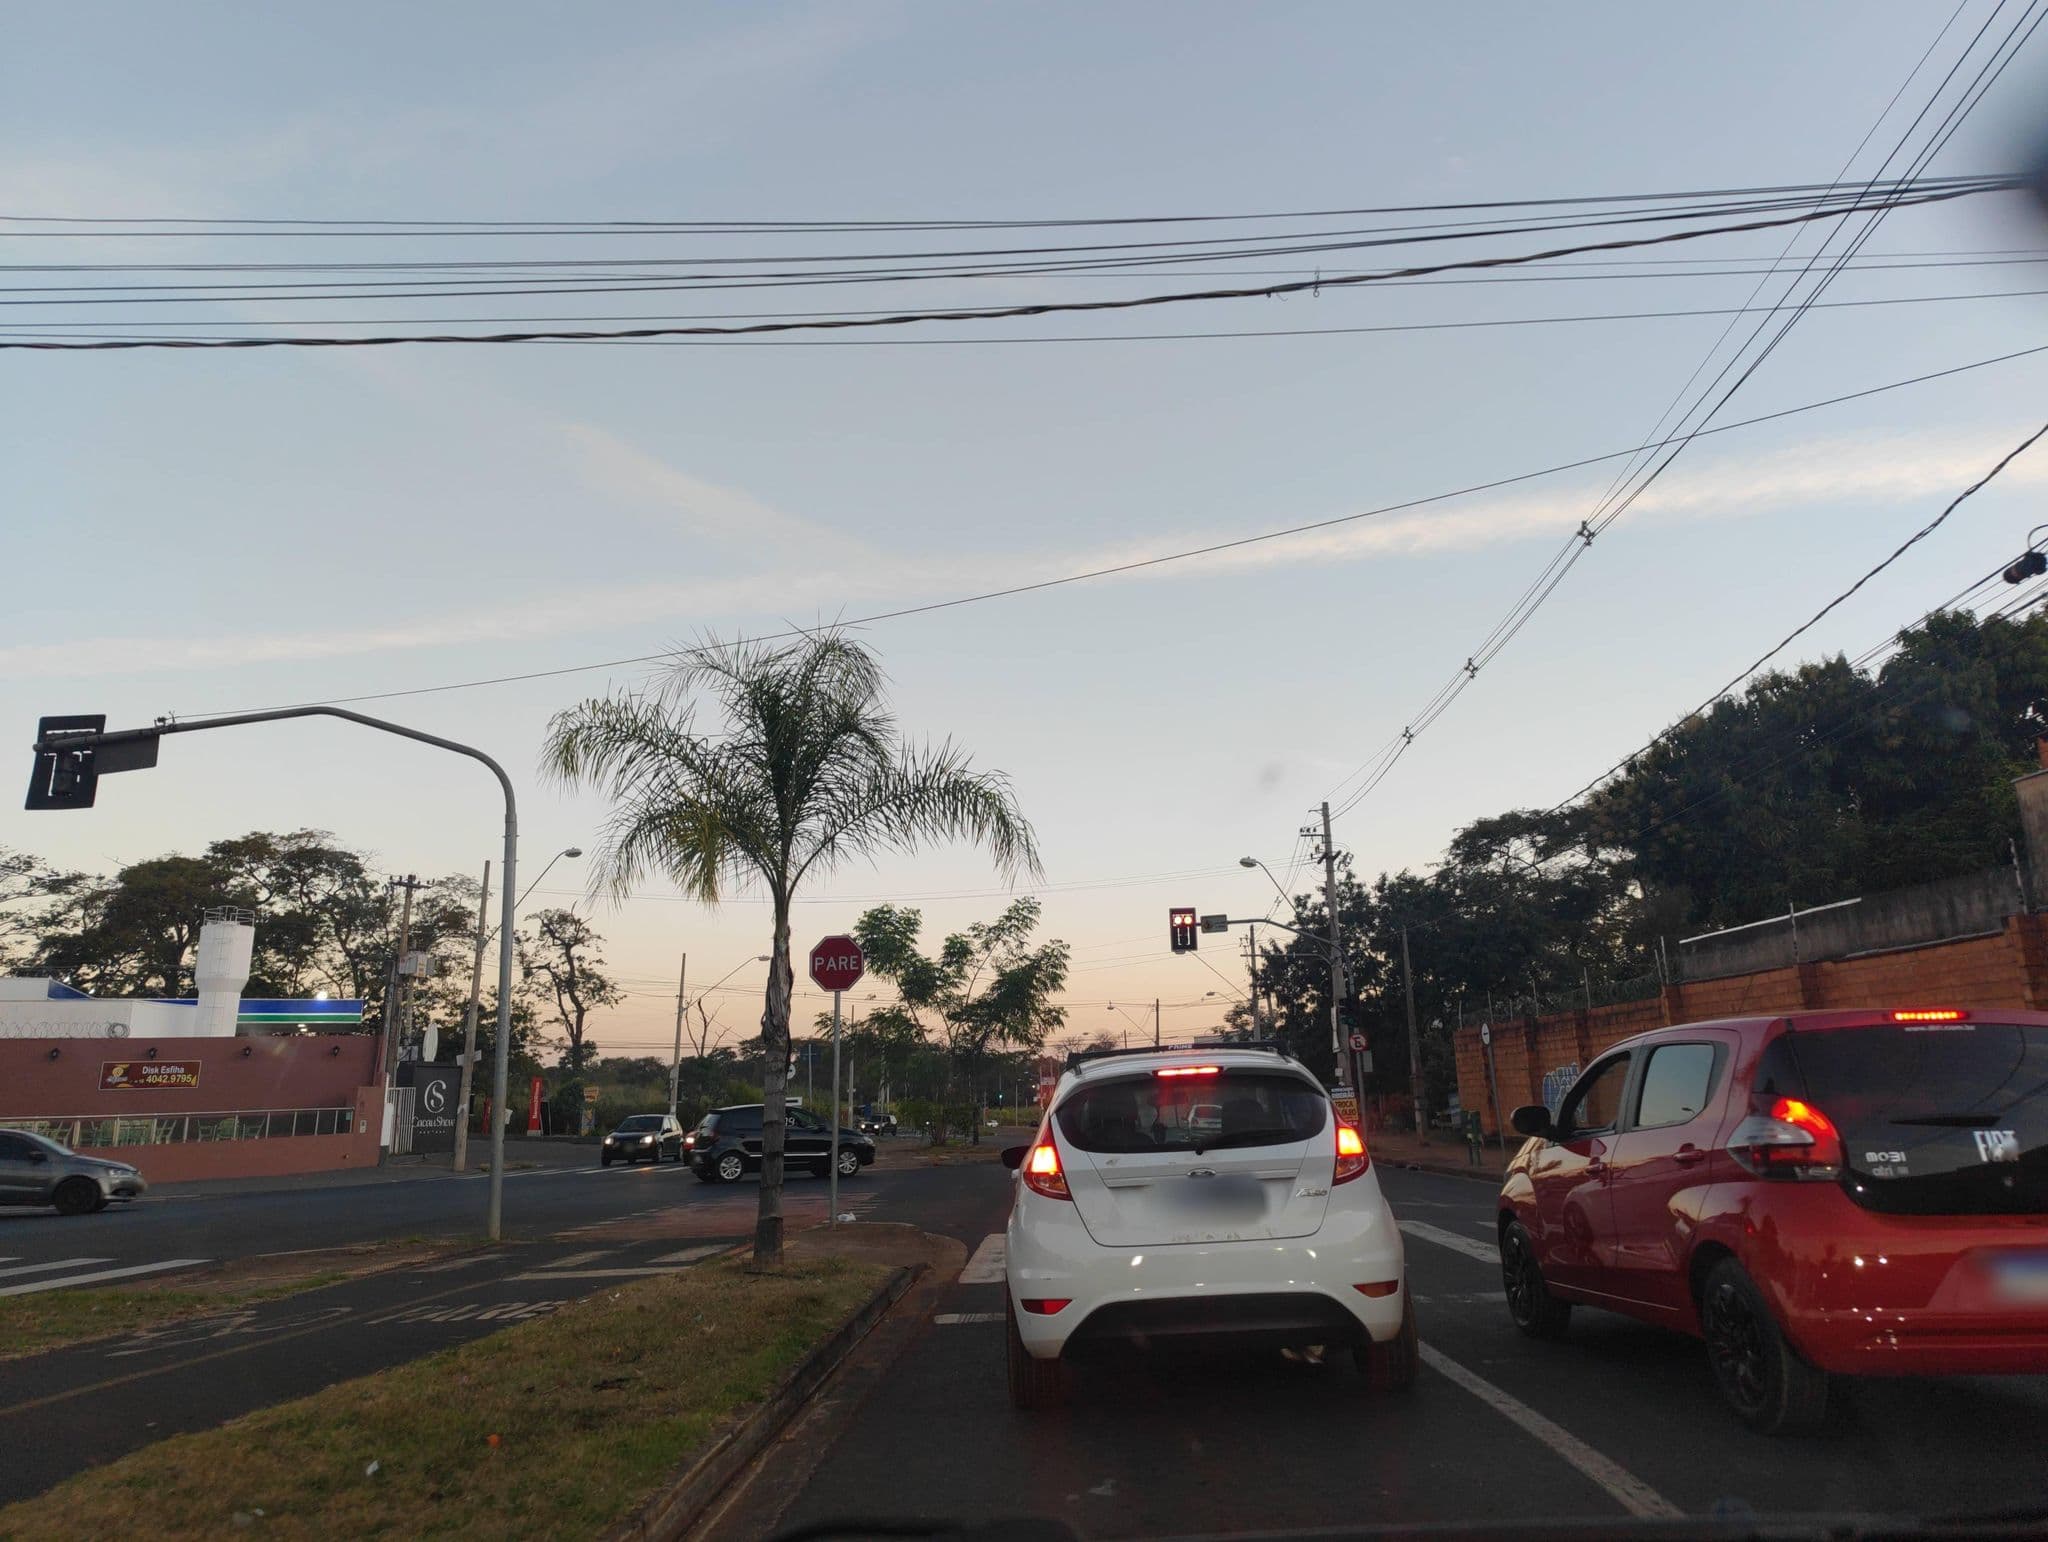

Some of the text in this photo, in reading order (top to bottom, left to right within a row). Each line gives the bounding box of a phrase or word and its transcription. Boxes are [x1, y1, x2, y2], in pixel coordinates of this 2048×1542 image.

[814, 955, 859, 972] PARE
[142, 1065, 185, 1074] Disk Esfiha
[146, 1074, 192, 1084] 4042.9795
[1973, 1130, 2018, 1162] FIAT
